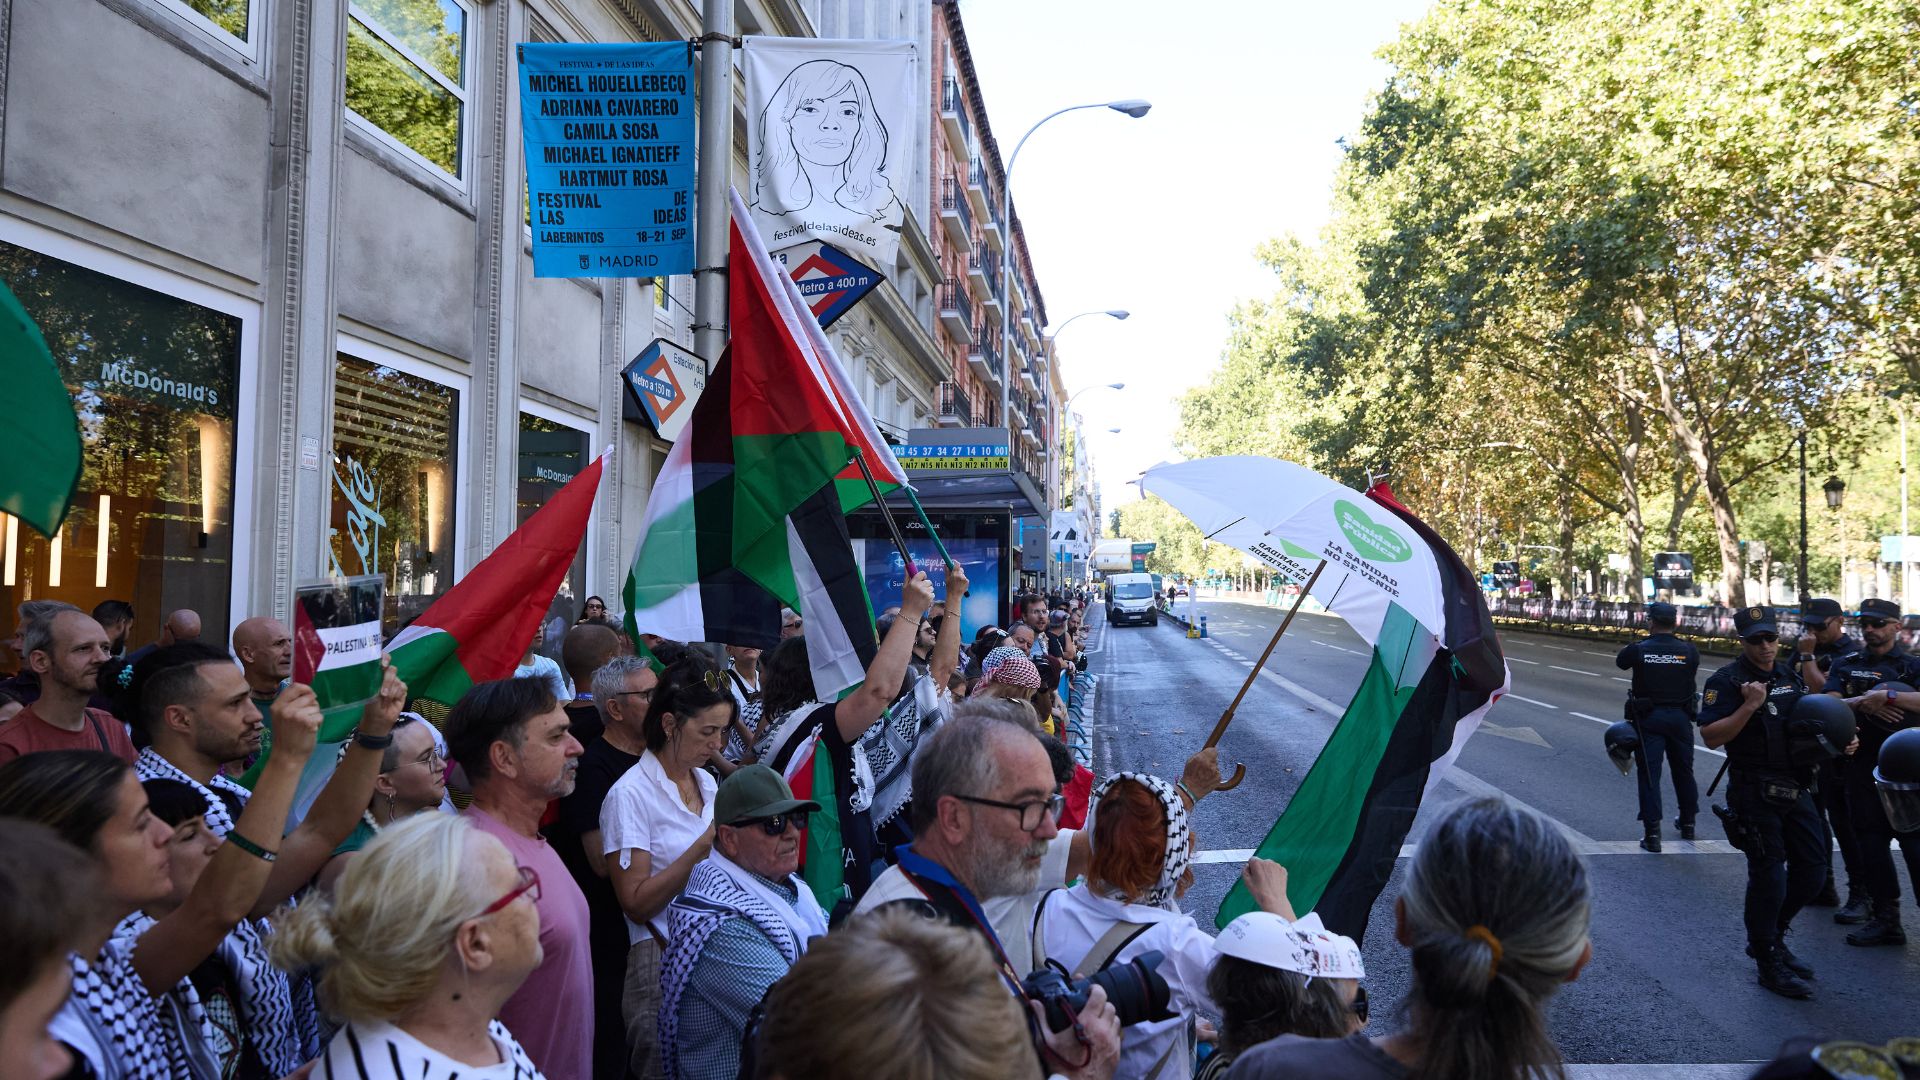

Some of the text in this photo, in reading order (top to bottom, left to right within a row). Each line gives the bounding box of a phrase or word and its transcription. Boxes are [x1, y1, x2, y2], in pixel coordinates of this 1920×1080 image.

[559, 61, 655, 69] FESTIVAL DE LAS IDEAS
[528, 74, 687, 96] MICHEL HOUELLEBECQ
[540, 98, 679, 117] ADRIANA CAVARERO
[563, 122, 660, 140] CAMILA SOSA
[543, 145, 680, 164] MICHAEL IGNATIEFF
[559, 169, 669, 187] HARTMUT ROSA
[537, 190, 688, 209] FESTIVAL DE
[539, 208, 687, 225] LAS IDEAS
[540, 231, 605, 244] LABERINTOS
[671, 228, 687, 241] SEP
[773, 220, 877, 247] festivaldelasideas.es
[599, 254, 659, 268] MADRID
[797, 282, 825, 294] Metro
[837, 277, 855, 289] 400
[858, 276, 868, 286] m
[101, 362, 218, 405] McDonald's
[632, 371, 672, 398] Metro a 150 m
[908, 446, 918, 456] 45
[922, 446, 933, 456] 37
[937, 446, 947, 456] 34
[952, 446, 963, 456] 27
[967, 446, 976, 456] 14
[981, 446, 991, 456] 10
[994, 446, 1008, 456] 001
[1343, 511, 1400, 554] Sanidad
[1323, 548, 1400, 597] NO SE VENDE
[1327, 541, 1398, 587] LA SANIDAD
[1656, 569, 1692, 577] TISSOT
